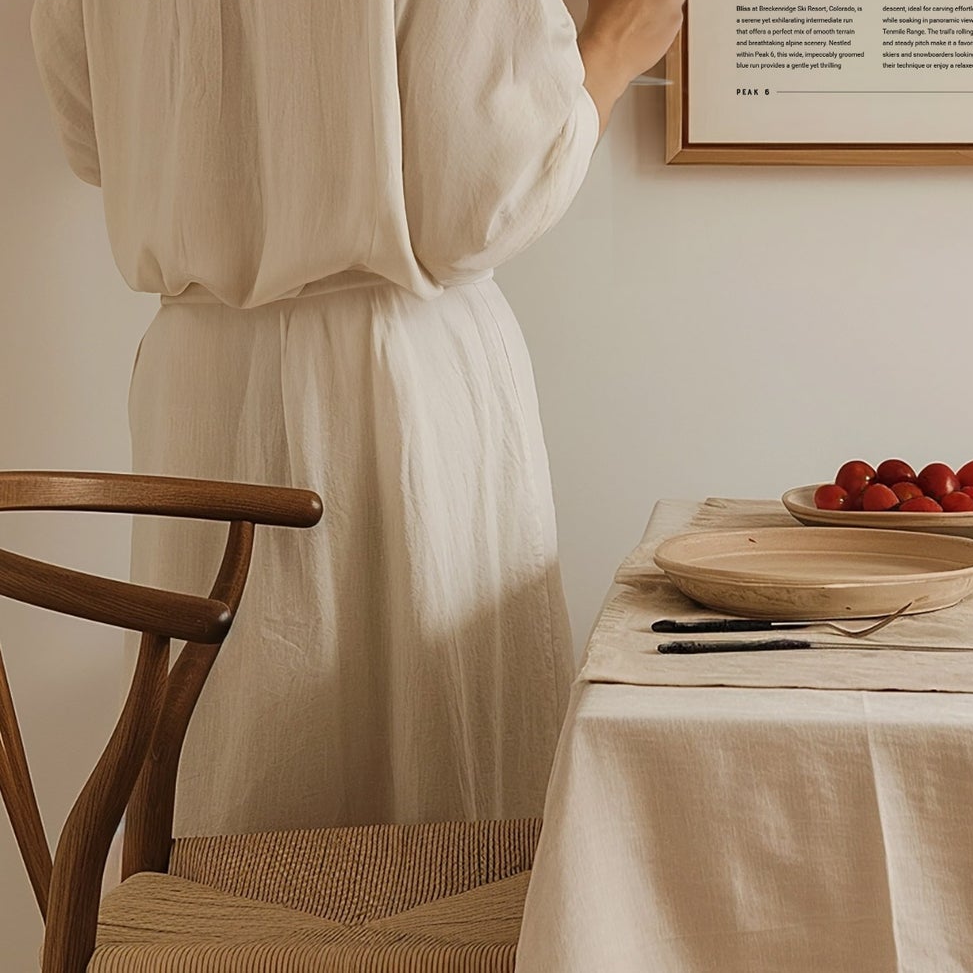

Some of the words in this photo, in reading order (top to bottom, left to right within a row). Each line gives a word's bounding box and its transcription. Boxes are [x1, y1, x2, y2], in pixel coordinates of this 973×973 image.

[759, 5, 797, 14] Breckenridge
[807, 5, 828, 13] Resort,
[828, 5, 857, 13] Colorado,
[882, 5, 907, 13] descent,
[932, 5, 954, 14] carving
[761, 17, 771, 25] yet
[771, 17, 805, 25] exhilarating
[898, 17, 922, 25] soaking
[928, 17, 960, 25] panoramic
[772, 28, 793, 37] perfect
[906, 28, 927, 37] Range.
[955, 28, 973, 37] rolling
[748, 39, 785, 48] breathtaking
[785, 39, 803, 48] alpine
[894, 39, 914, 48] steady
[914, 39, 930, 48] pitch
[788, 51, 804, 59] wide,
[804, 51, 838, 60] impeccably
[838, 51, 865, 60] groomed
[760, 62, 786, 71] provides
[790, 62, 809, 71] gentle
[809, 62, 820, 71] yet
[820, 62, 842, 71] thrilling
[896, 62, 925, 71] technique
[933, 62, 949, 71] enjoy
[736, 88, 759, 96] PEAK
[764, 88, 770, 96] 6
